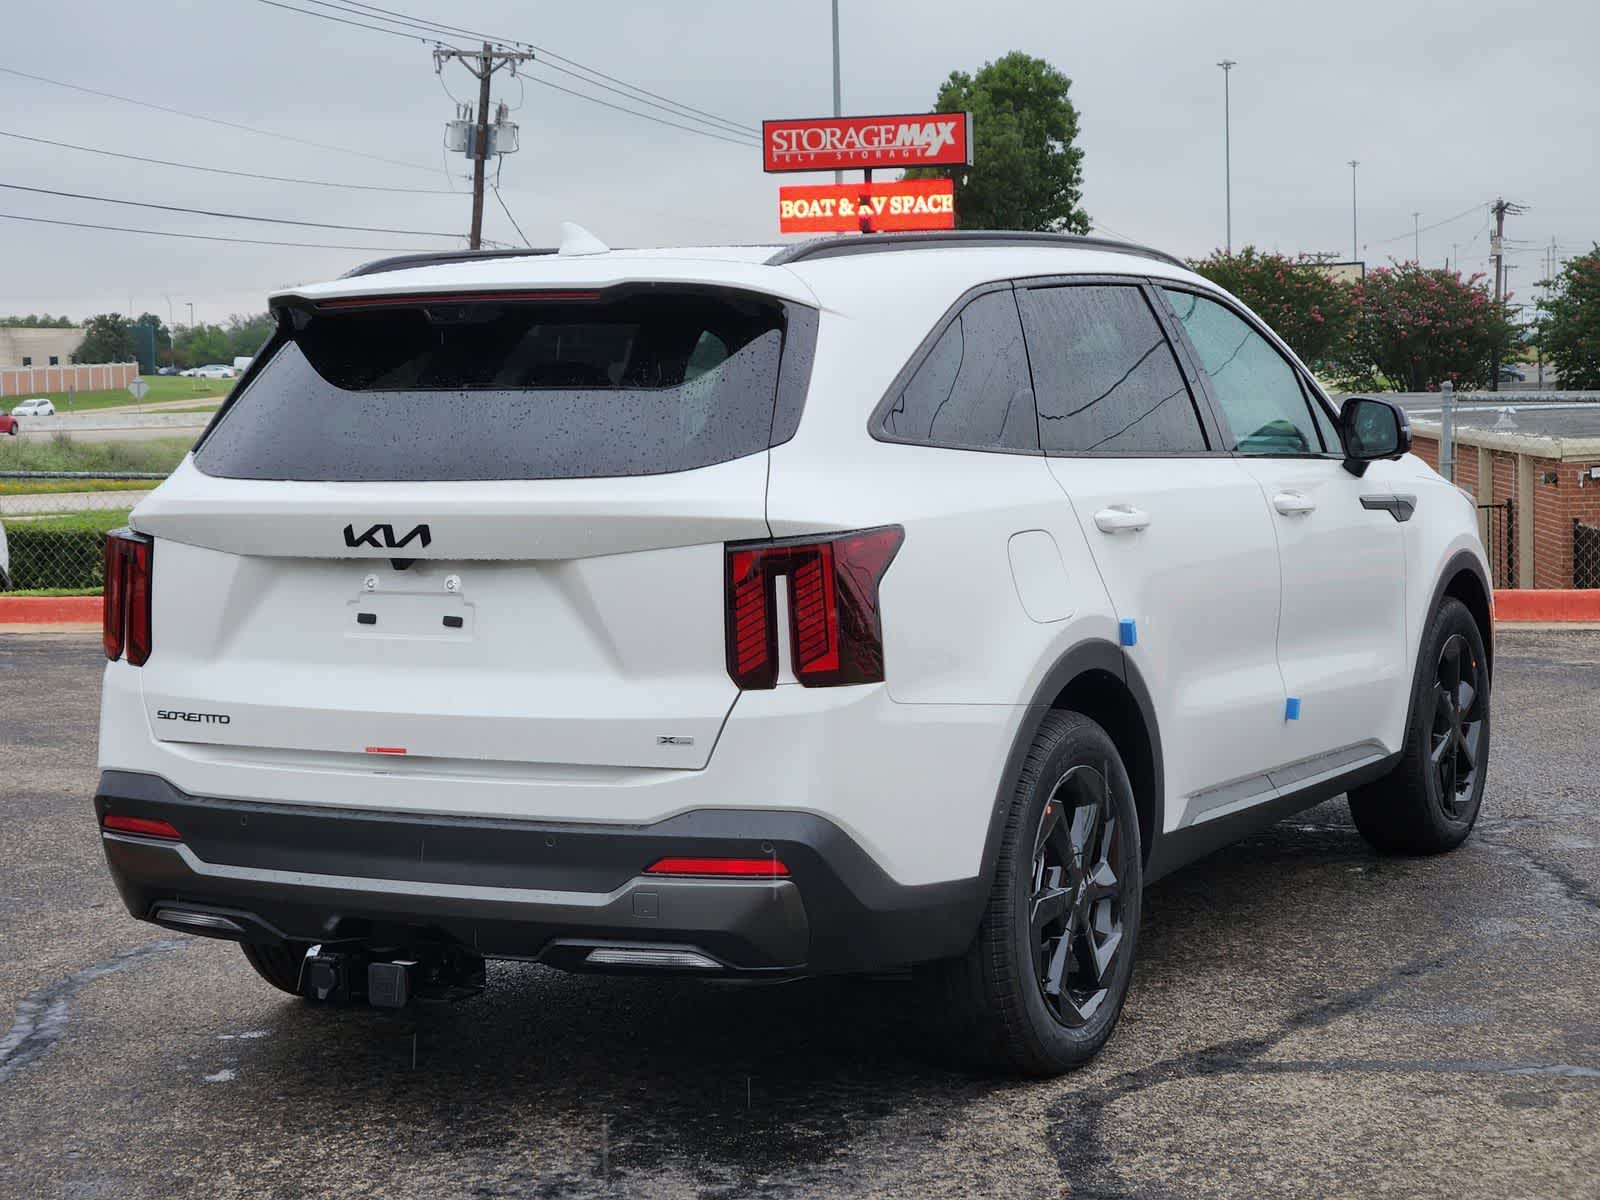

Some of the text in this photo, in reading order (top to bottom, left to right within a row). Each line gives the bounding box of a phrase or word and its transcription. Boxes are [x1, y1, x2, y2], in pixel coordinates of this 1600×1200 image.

[772, 149, 922, 162] SELF STORAGE
[781, 198, 836, 218] BOAT
[838, 197, 855, 216] &
[889, 194, 953, 215] SPACE
[343, 523, 431, 548] KIA
[157, 710, 230, 724] SORENTO
